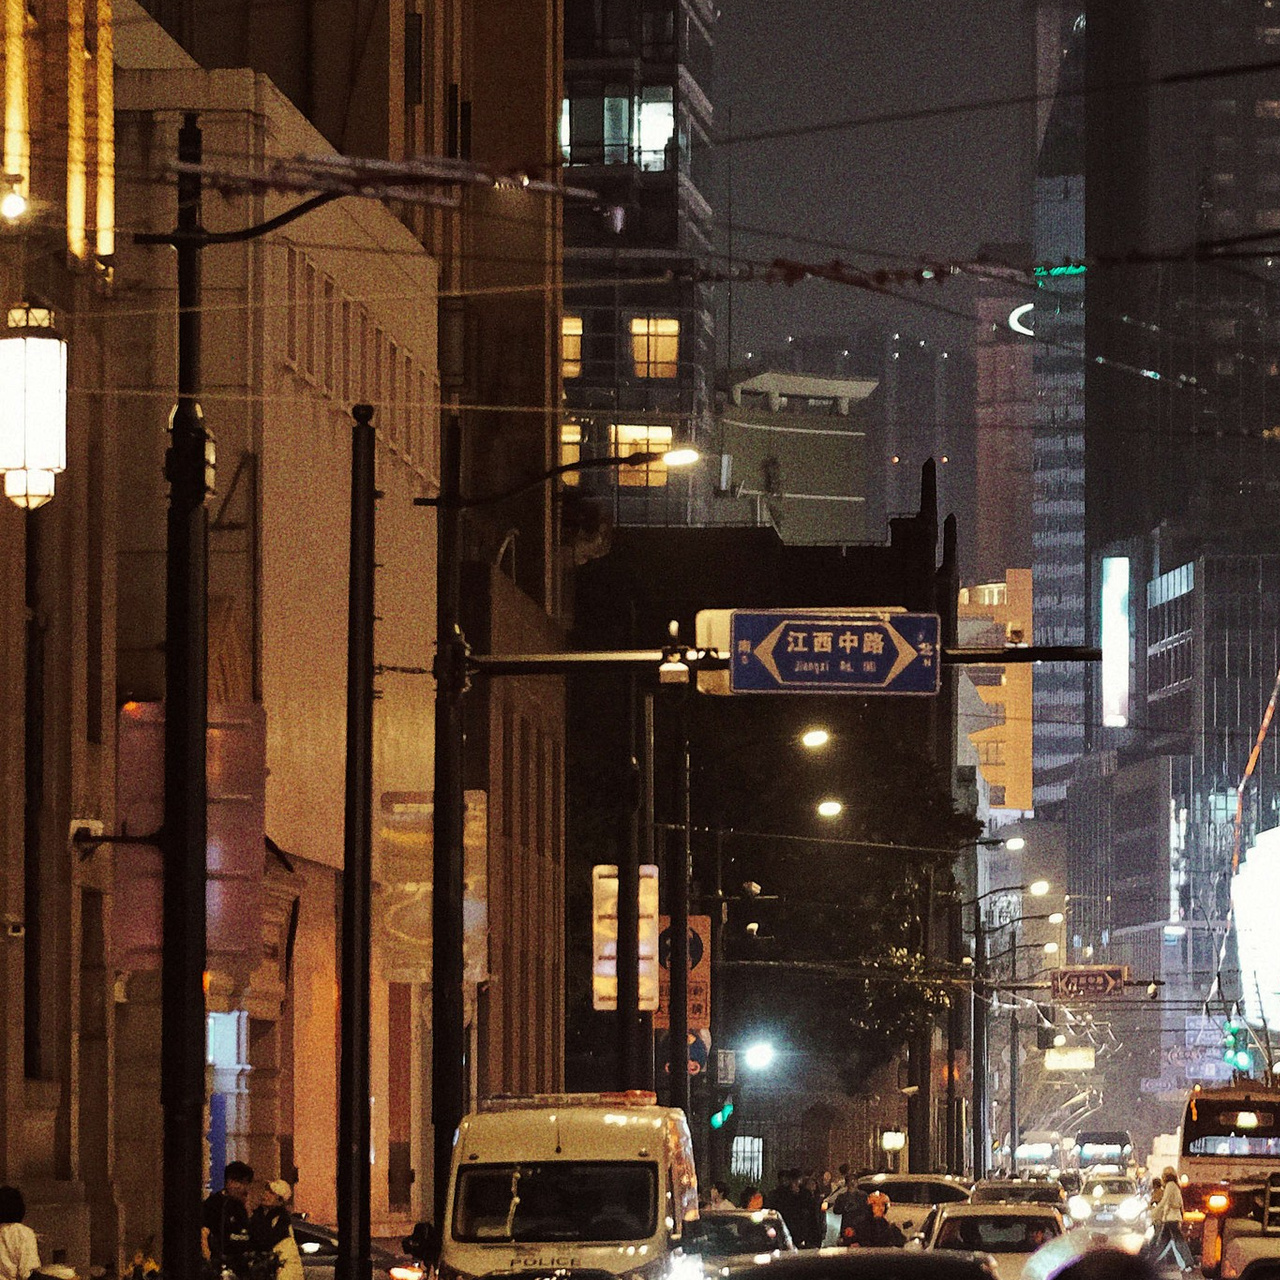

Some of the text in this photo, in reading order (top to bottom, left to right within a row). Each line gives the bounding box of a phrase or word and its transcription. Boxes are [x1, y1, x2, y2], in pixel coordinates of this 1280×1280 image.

[786, 630, 884, 655] 江西中路
[795, 661, 830, 674] Jiangxi
[510, 1258, 583, 1267] POLICE
